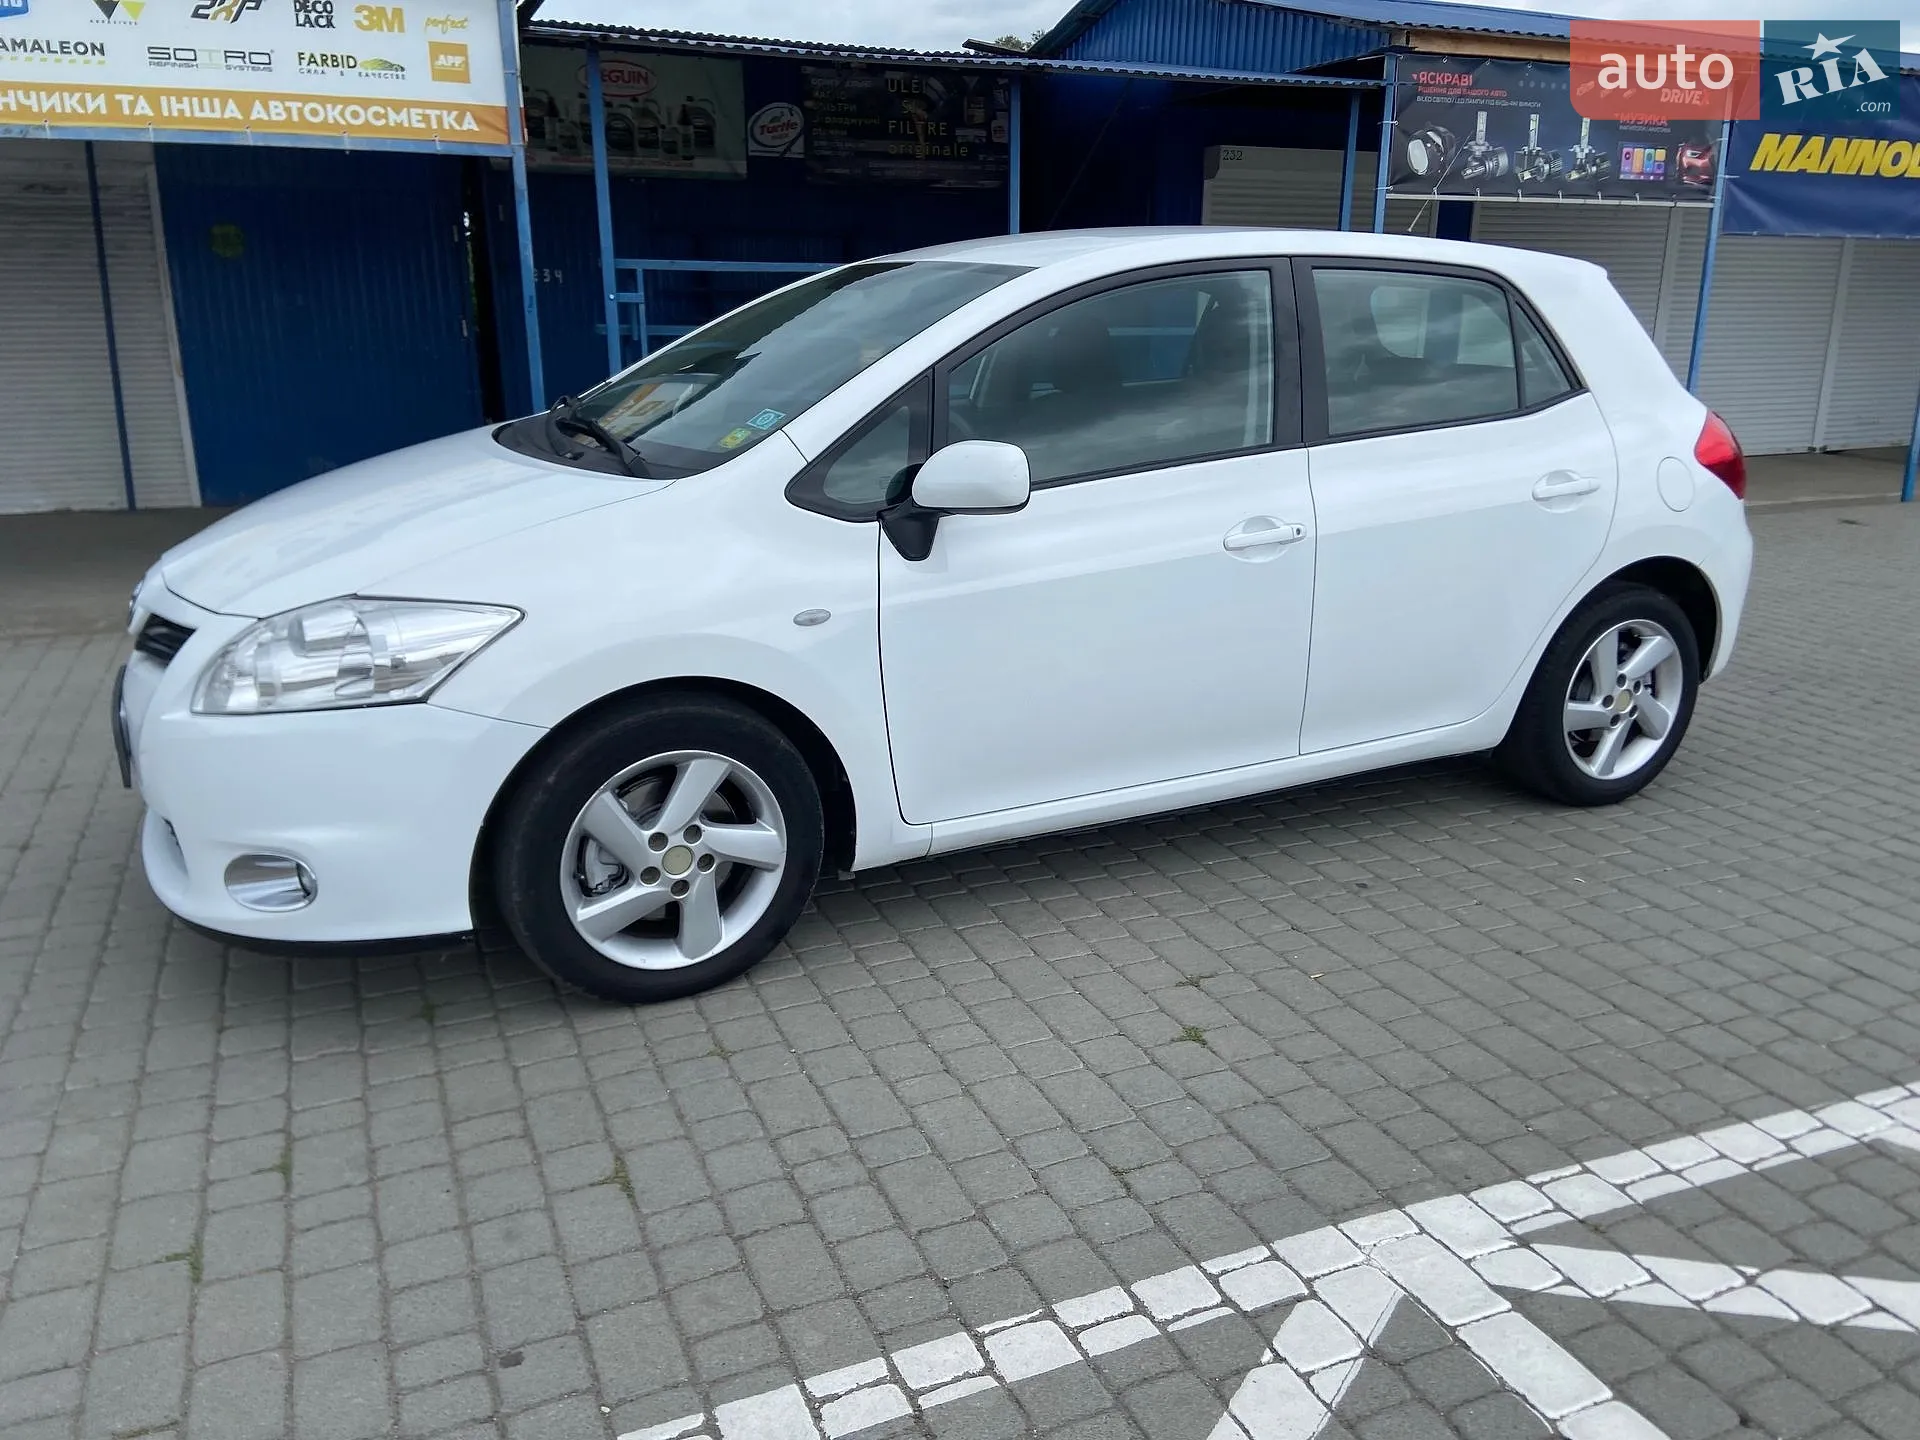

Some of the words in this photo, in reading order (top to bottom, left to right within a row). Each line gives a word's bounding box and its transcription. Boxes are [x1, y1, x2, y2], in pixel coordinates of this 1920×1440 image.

[294, 0, 333, 14] DECO
[295, 13, 335, 28] LACK
[354, 4, 406, 33] 3M
[424, 14, 469, 34] perfect
[225, 64, 273, 73] SYSTEMS
[298, 52, 357, 69] FARBID
[600, 69, 649, 85] EGUIN
[1419, 71, 1473, 87] ЯСКРАВІ
[114, 93, 154, 117] ТА
[160, 95, 243, 120] ІНША
[250, 99, 480, 132] АВТОКОСМЕТКА
